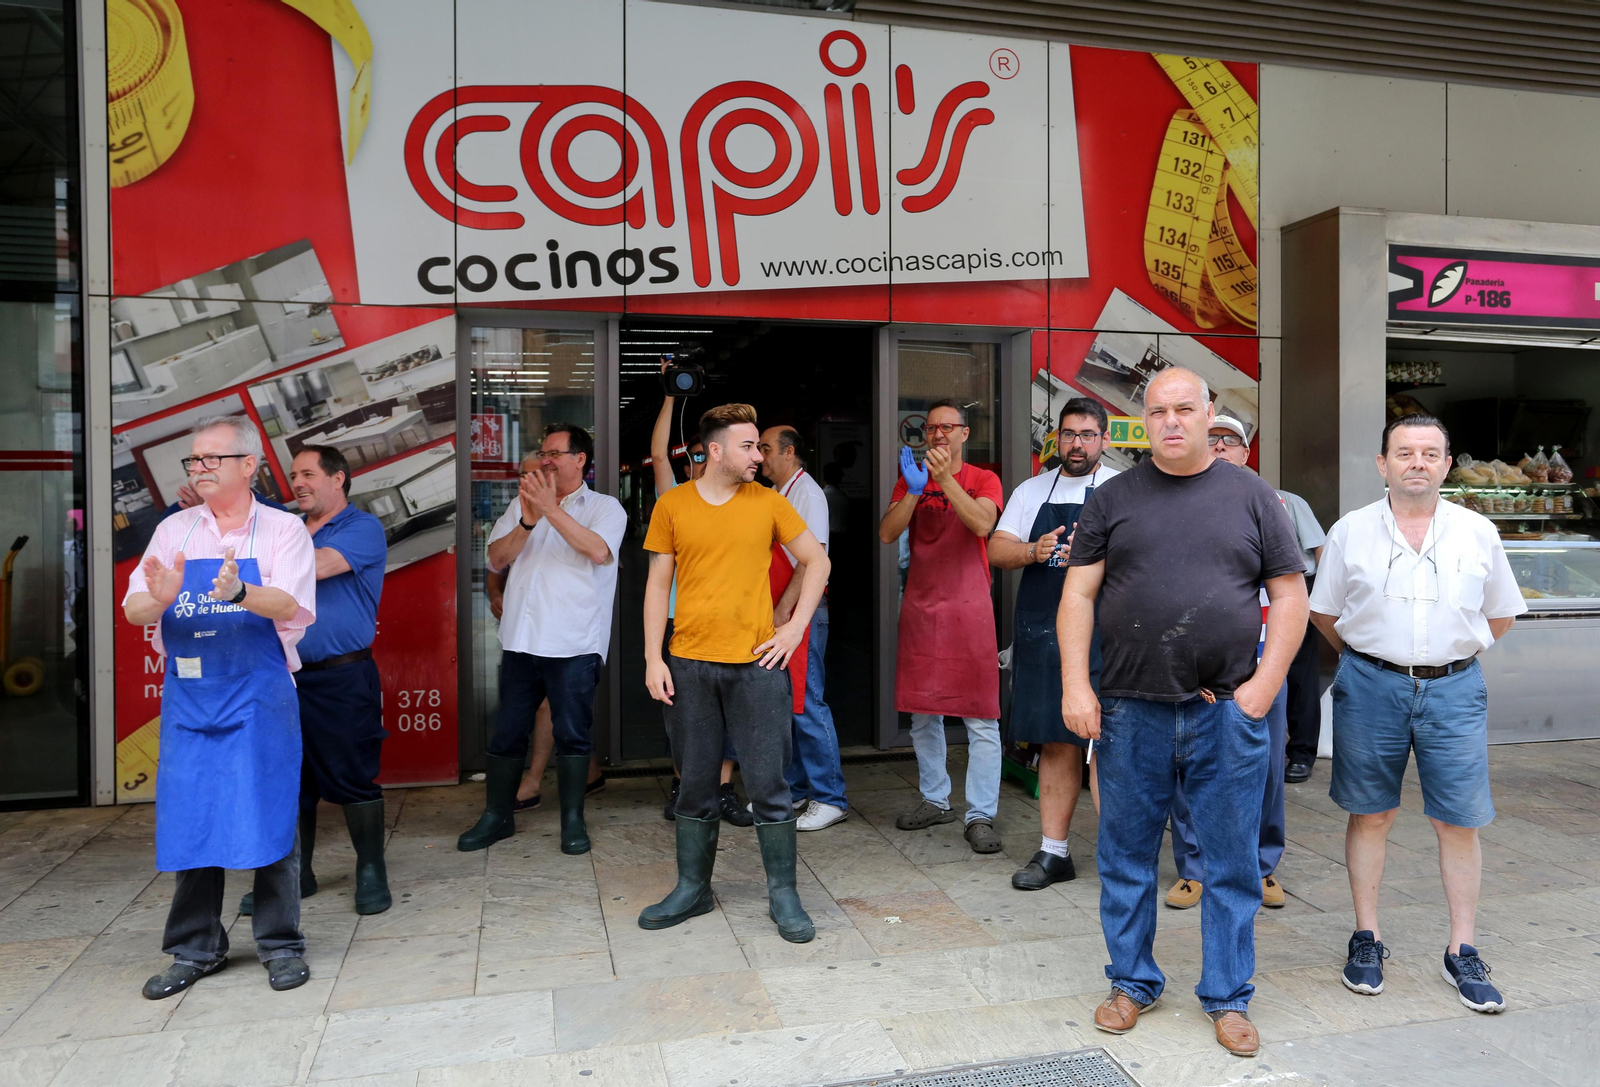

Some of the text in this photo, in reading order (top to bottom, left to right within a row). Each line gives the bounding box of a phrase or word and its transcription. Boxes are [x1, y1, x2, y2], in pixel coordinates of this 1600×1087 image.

[1203, 81, 1217, 95] 6
[1223, 107, 1235, 122] 7
[1182, 130, 1206, 147] 131
[1174, 157, 1202, 179] 132
[1166, 189, 1194, 213] 133
[1159, 226, 1187, 249] 134
[418, 239, 680, 294] cocinas
[760, 247, 1064, 279] www.cocinascapis.com
[1154, 259, 1181, 280] 135
[1212, 253, 1235, 272] 115
[1230, 280, 1254, 295] 116
[197, 603, 248, 615] de Huelv
[398, 689, 441, 708] 378
[398, 713, 441, 732] 086
